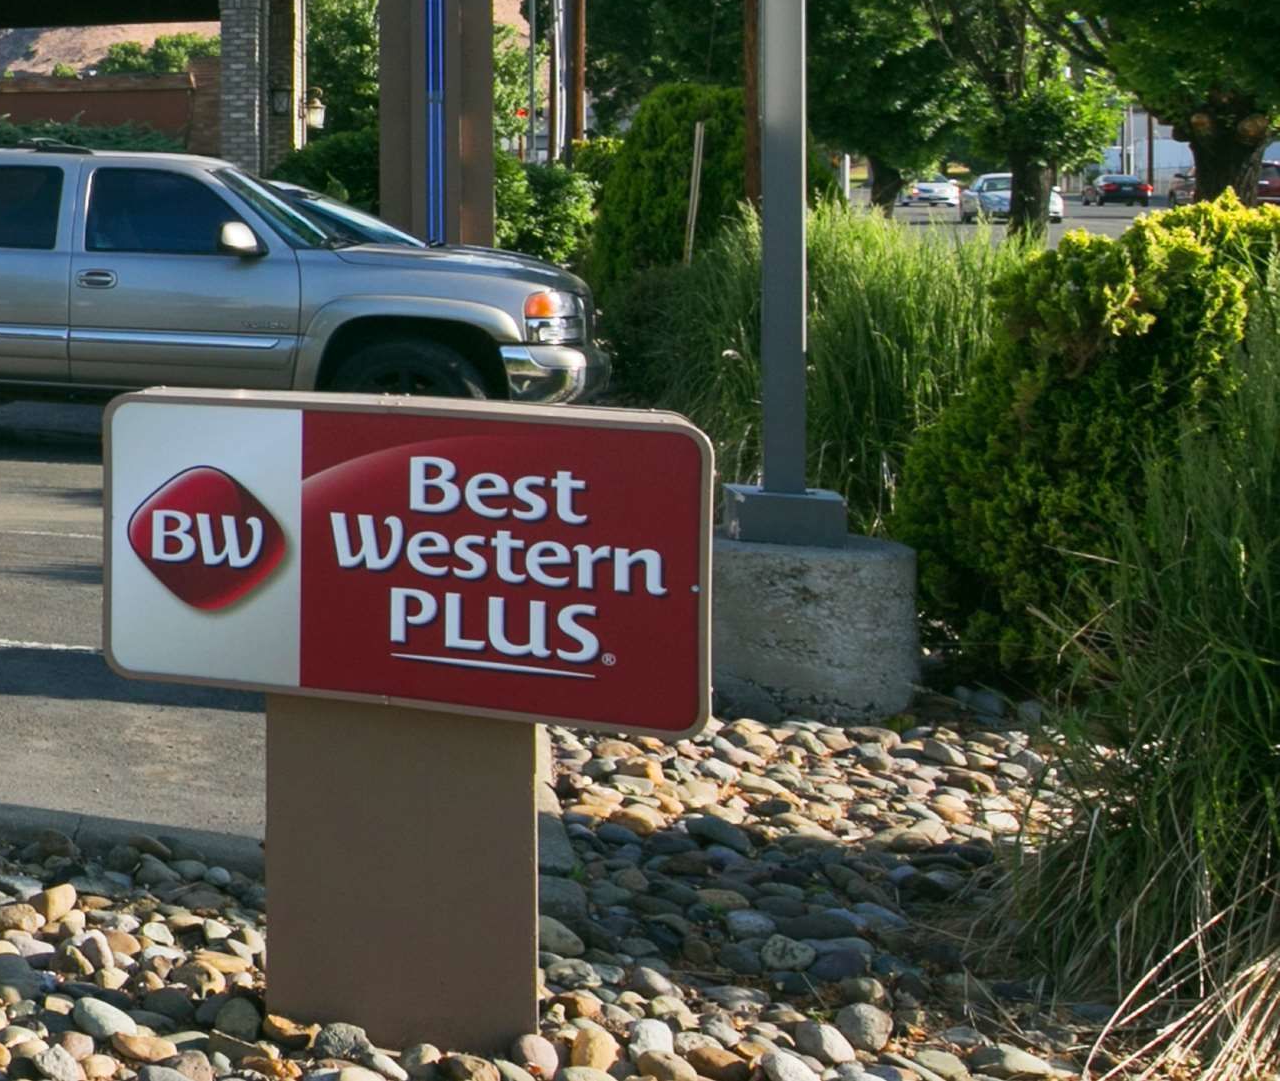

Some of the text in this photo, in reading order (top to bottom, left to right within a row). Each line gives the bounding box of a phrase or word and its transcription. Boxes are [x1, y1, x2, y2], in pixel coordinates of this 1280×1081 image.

[408, 455, 588, 524] Best
[150, 508, 264, 568] BW
[330, 511, 668, 596] Western
